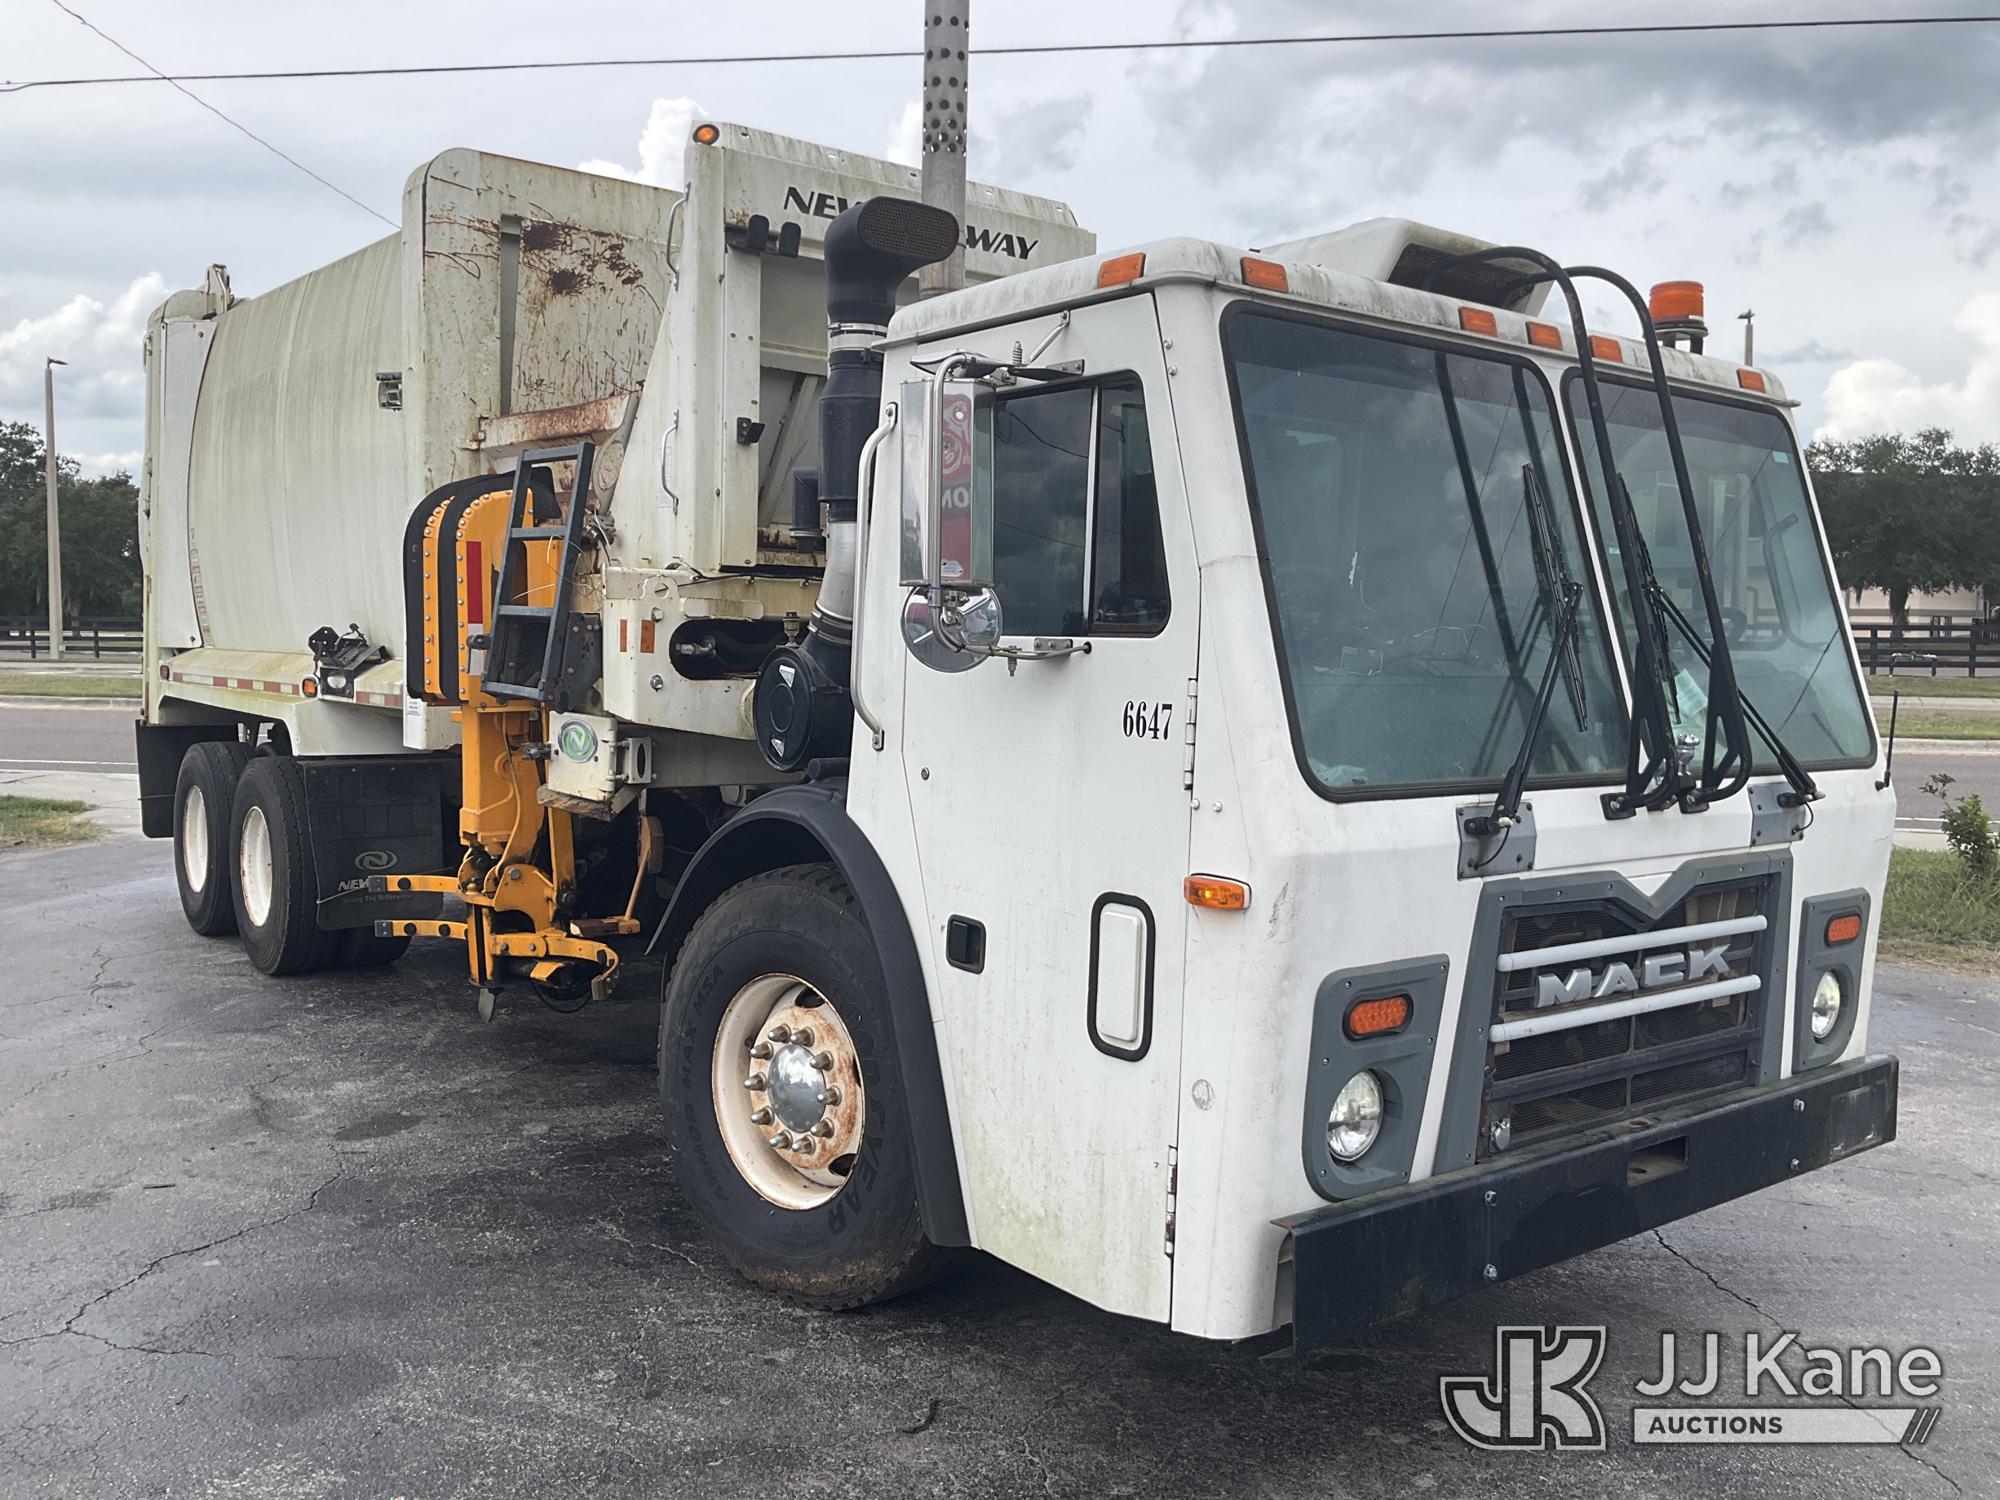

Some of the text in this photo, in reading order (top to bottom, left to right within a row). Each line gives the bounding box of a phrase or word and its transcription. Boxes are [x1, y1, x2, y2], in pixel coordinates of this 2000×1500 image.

[966, 225, 1039, 260] WAY
[1123, 700, 1173, 740] 6647
[1534, 944, 1731, 1008] MACK
